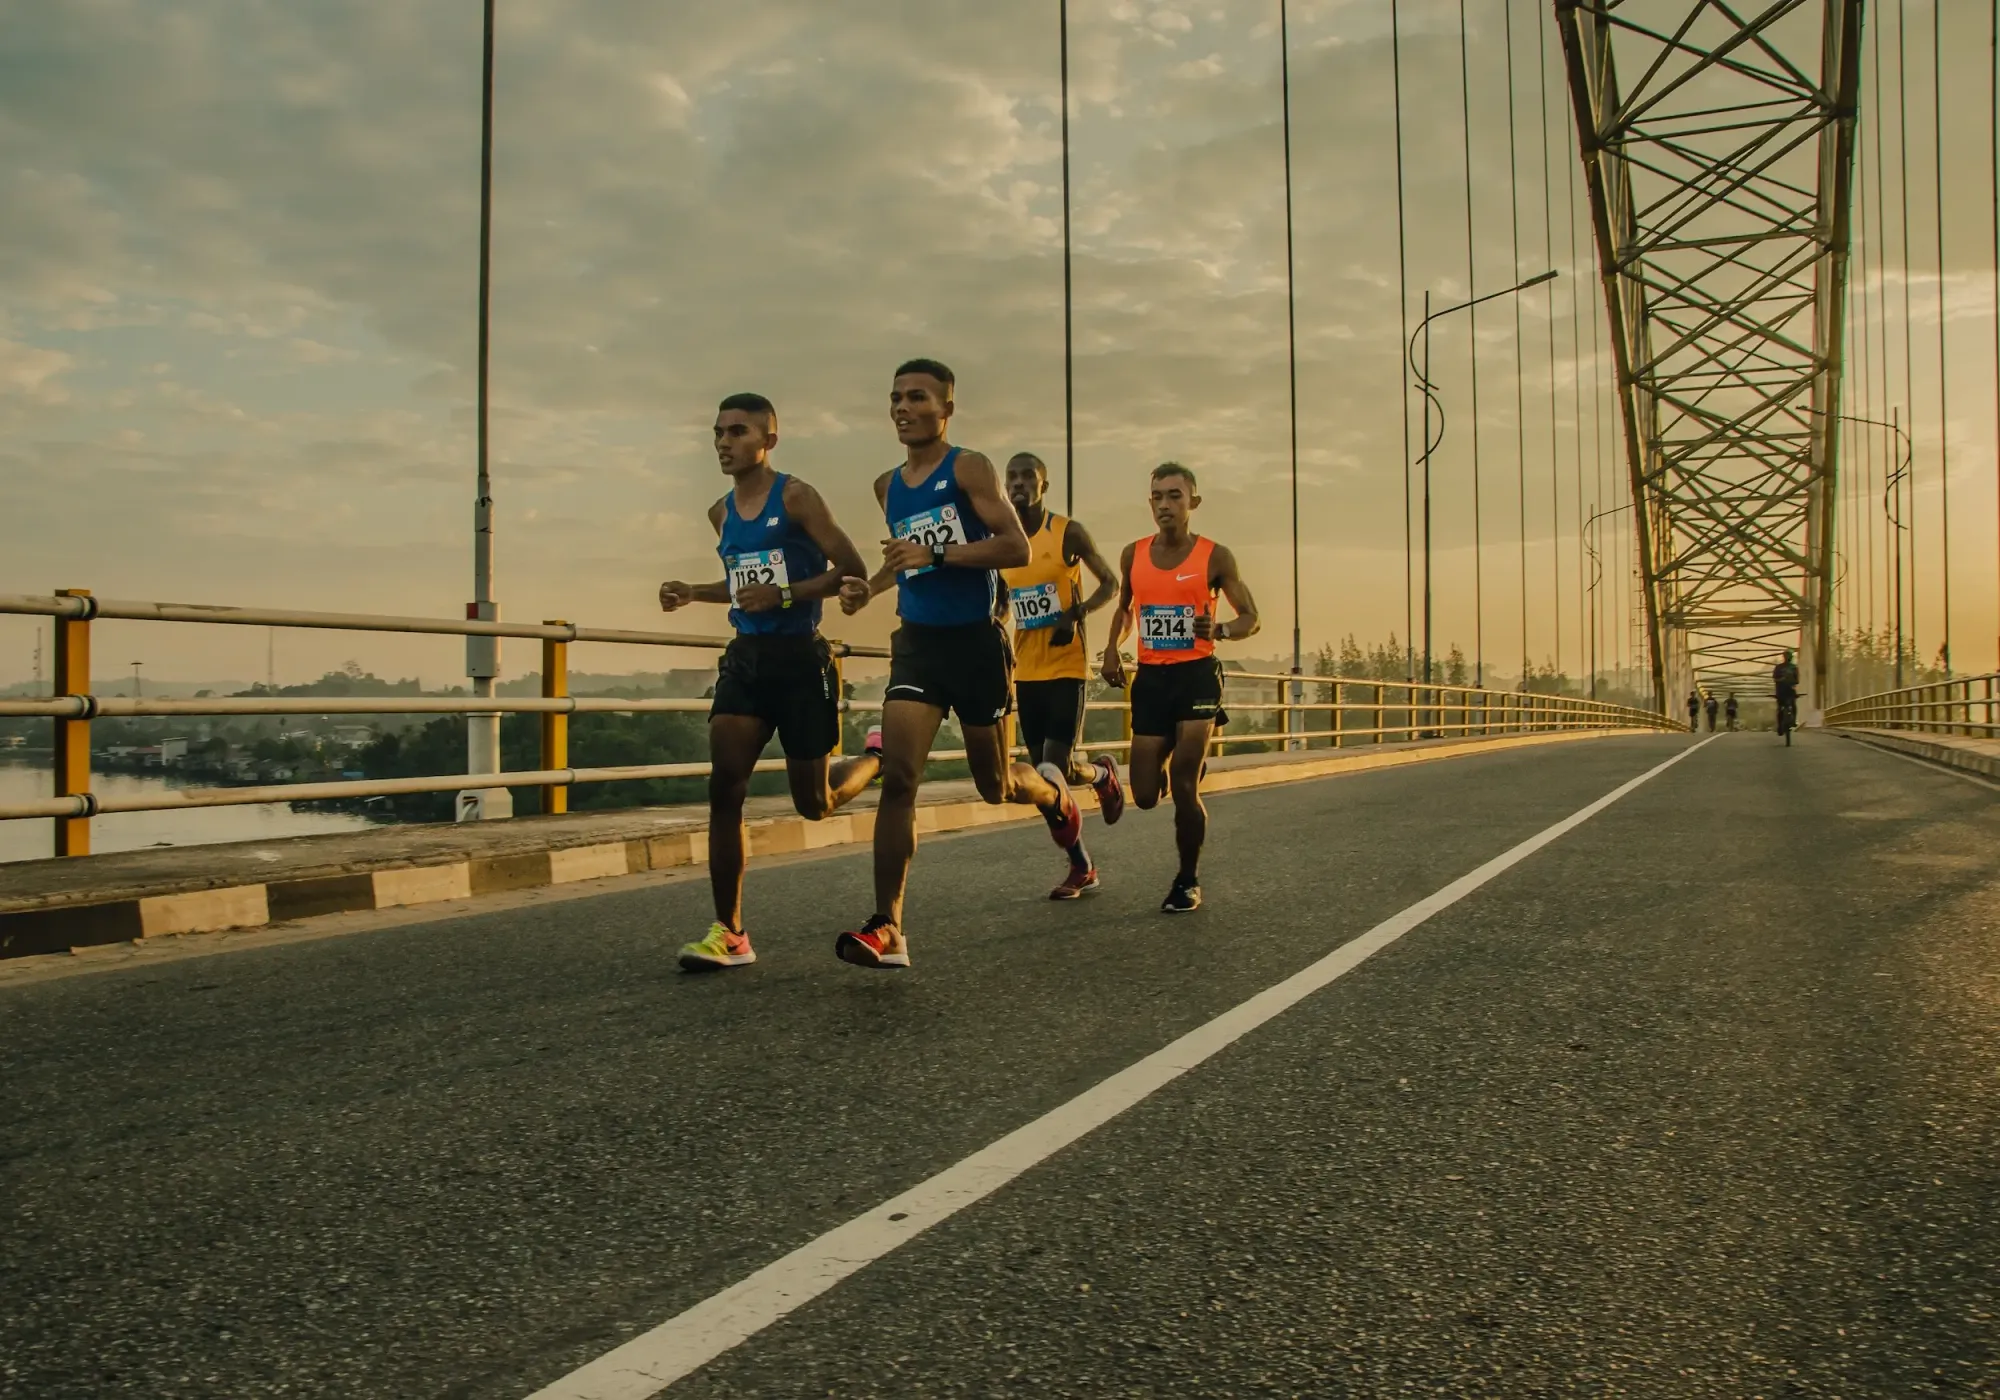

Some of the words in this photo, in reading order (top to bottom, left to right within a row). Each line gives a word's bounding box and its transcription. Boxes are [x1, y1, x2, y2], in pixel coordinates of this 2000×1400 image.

[735, 567, 778, 588] 1182
[1015, 597, 1051, 618] 1109
[1145, 618, 1187, 637] 1214
